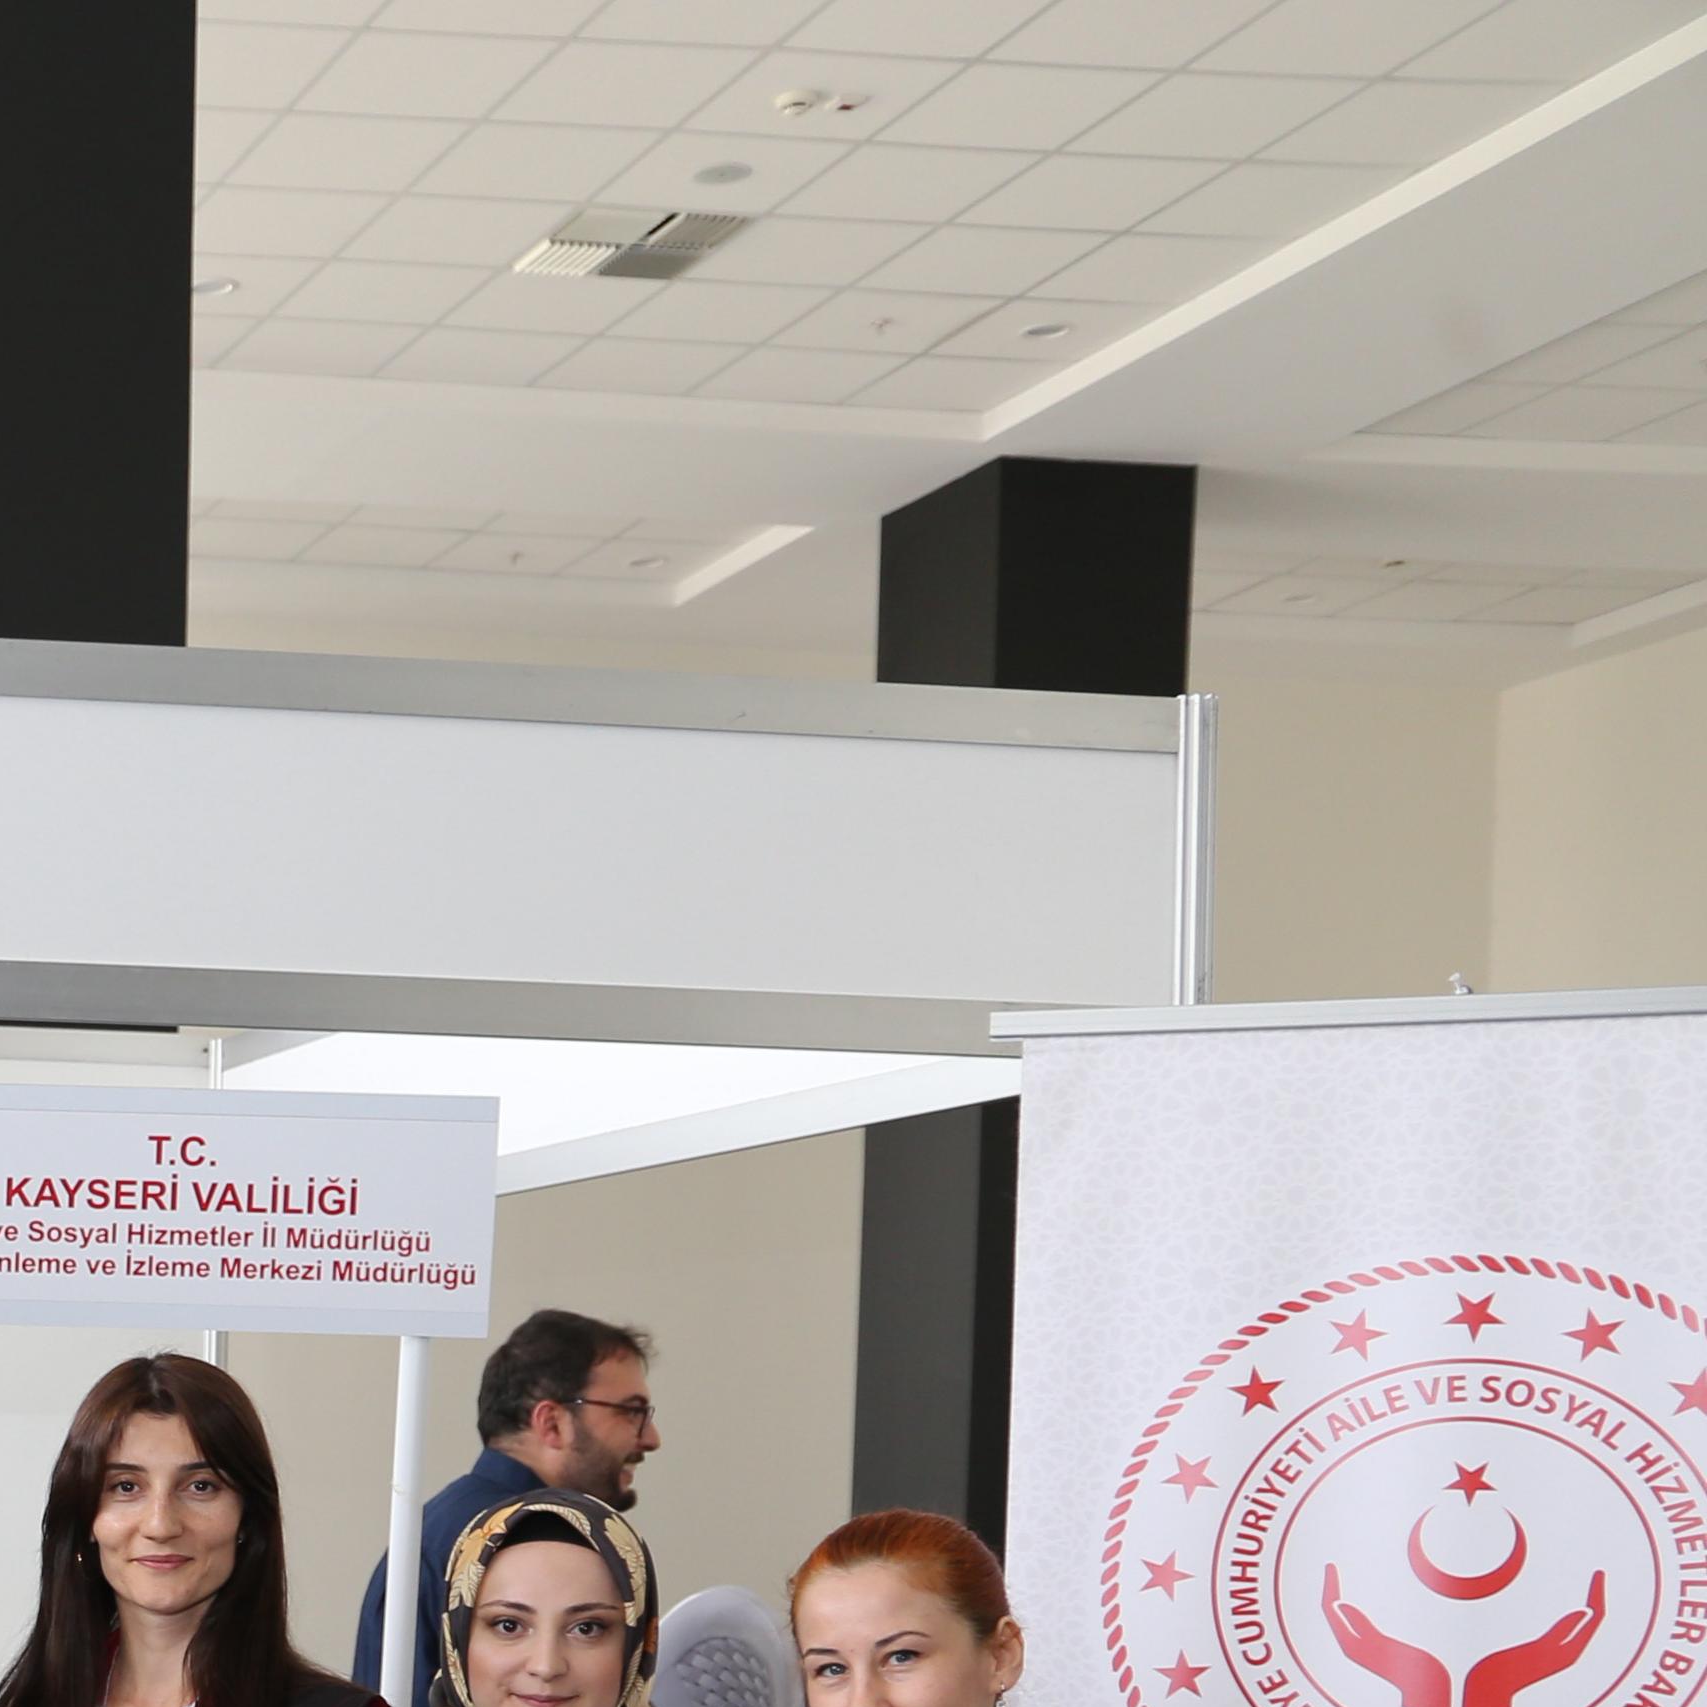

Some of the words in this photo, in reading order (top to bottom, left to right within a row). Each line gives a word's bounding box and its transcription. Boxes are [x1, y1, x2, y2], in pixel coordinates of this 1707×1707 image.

[148, 1135, 217, 1167] T.C.
[5, 1173, 180, 1211] KAYSERİ
[192, 1176, 359, 1216] VALİLİĞİ
[27, 1220, 118, 1249] Sosyal
[127, 1223, 254, 1248] Hizmetler
[262, 1221, 277, 1248] İl
[287, 1227, 432, 1258] Müdürlüğü
[85, 1258, 117, 1276] ve
[126, 1250, 211, 1279] İzleme
[220, 1257, 323, 1282] Merkezi
[332, 1260, 477, 1291] Müdürlüğü
[1229, 1426, 1331, 1668] CUMHURİYETİ
[1324, 1382, 1409, 1444] AİLE
[1413, 1374, 1469, 1406] VE
[1479, 1375, 1627, 1451] SOSYAL
[1624, 1441, 1707, 1644] HİZMETLER
